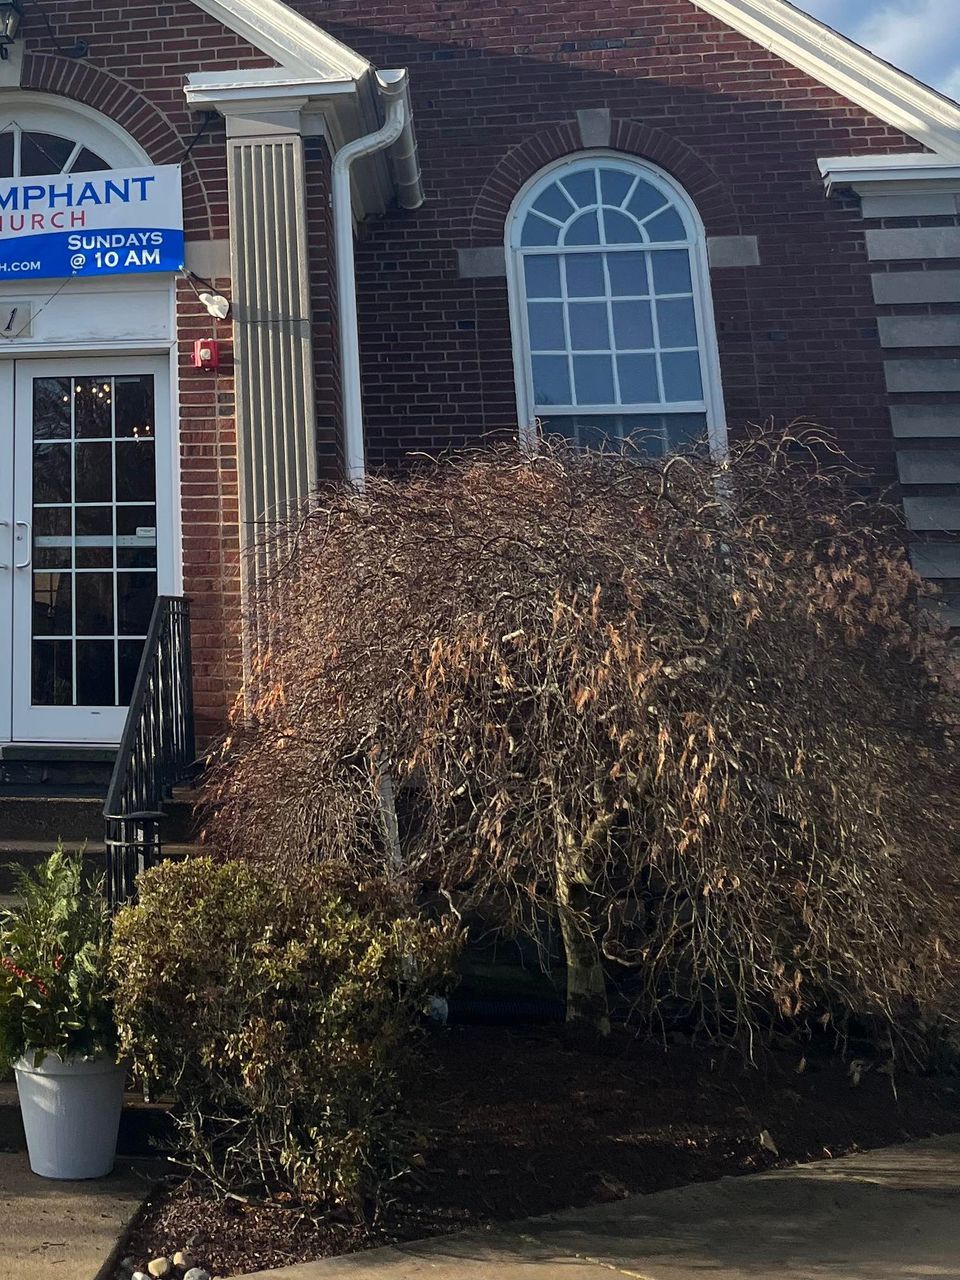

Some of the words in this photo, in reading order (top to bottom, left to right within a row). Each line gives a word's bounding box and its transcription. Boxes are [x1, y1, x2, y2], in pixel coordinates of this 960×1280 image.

[67, 232, 163, 251] SUNDAYS
[70, 254, 86, 269] @
[95, 251, 119, 268] 10
[124, 249, 161, 267] AM
[4, 307, 17, 332] 1
